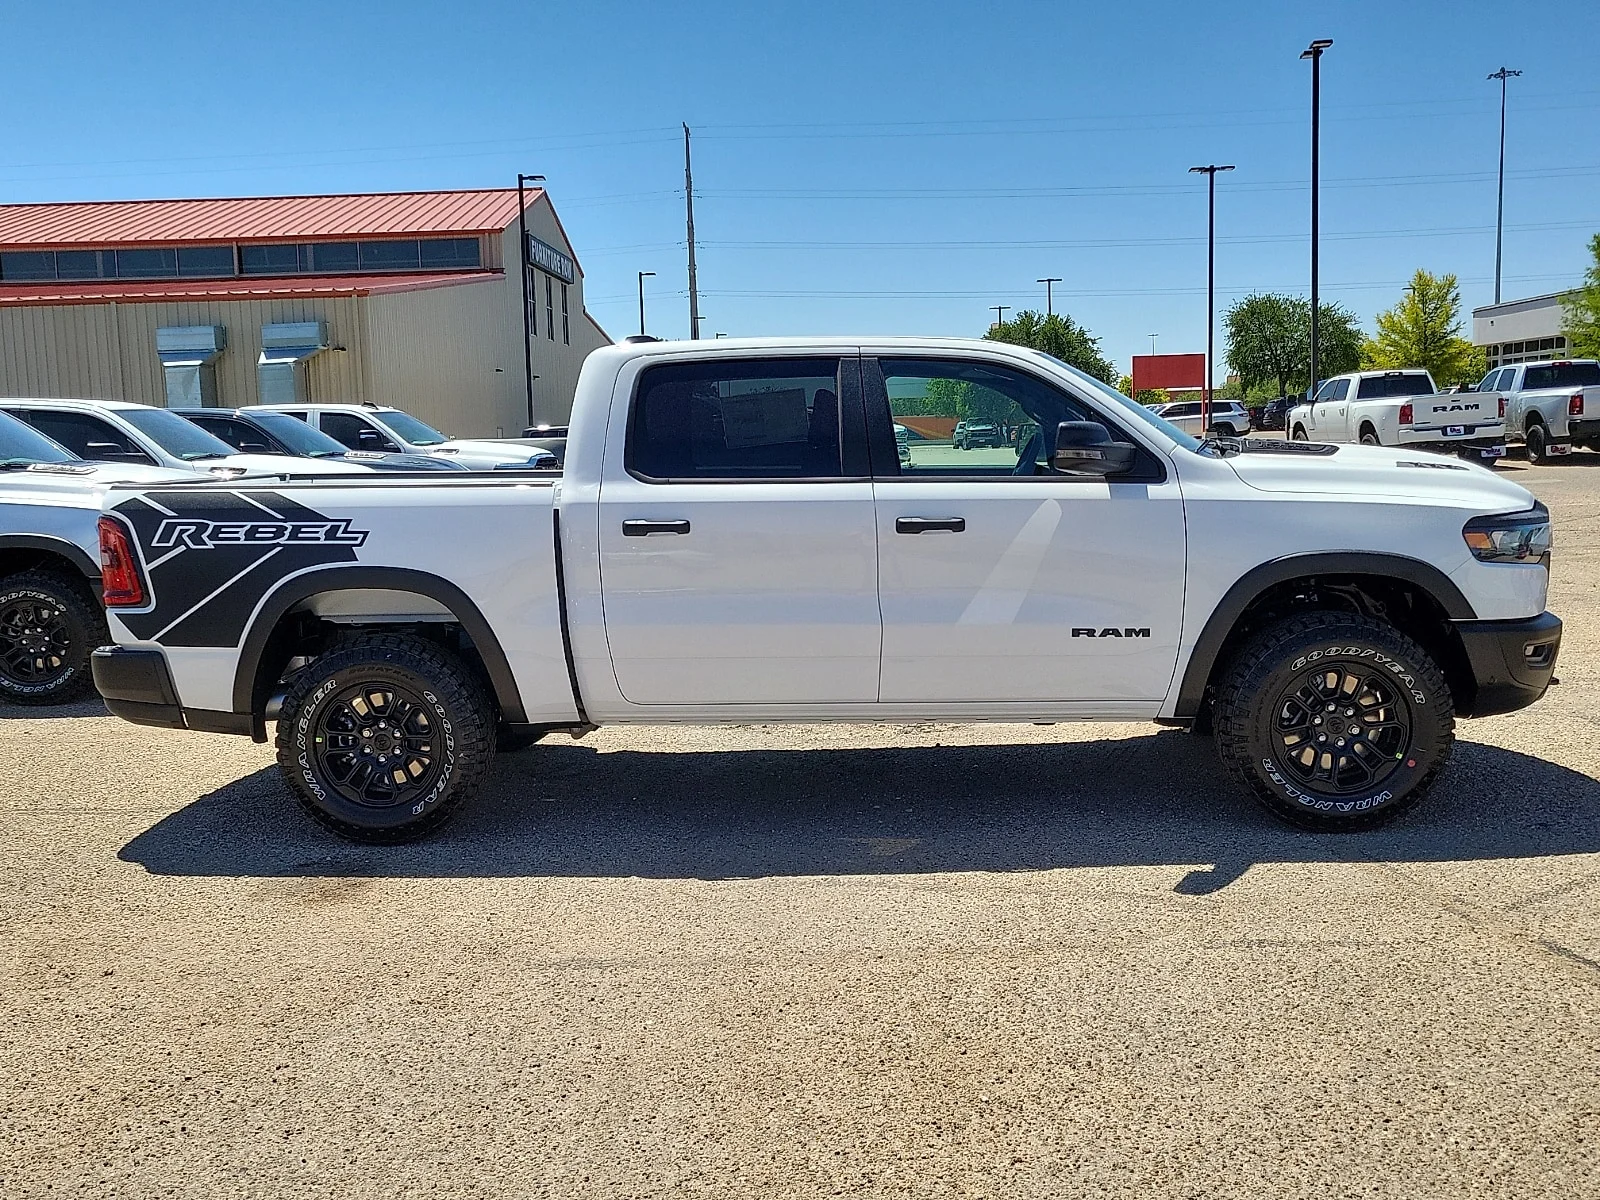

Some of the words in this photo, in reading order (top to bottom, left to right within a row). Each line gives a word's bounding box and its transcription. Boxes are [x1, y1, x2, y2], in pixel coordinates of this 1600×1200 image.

[531, 239, 561, 274] FURNITURE
[1432, 403, 1480, 413] RAM
[151, 517, 369, 549] REBEL
[1071, 627, 1151, 638] RAM
[1291, 646, 1426, 704] GOODYEAR
[296, 679, 338, 801] WRANGLER
[411, 690, 455, 815] GOODYEAR
[1262, 757, 1393, 812] WRANGLER
